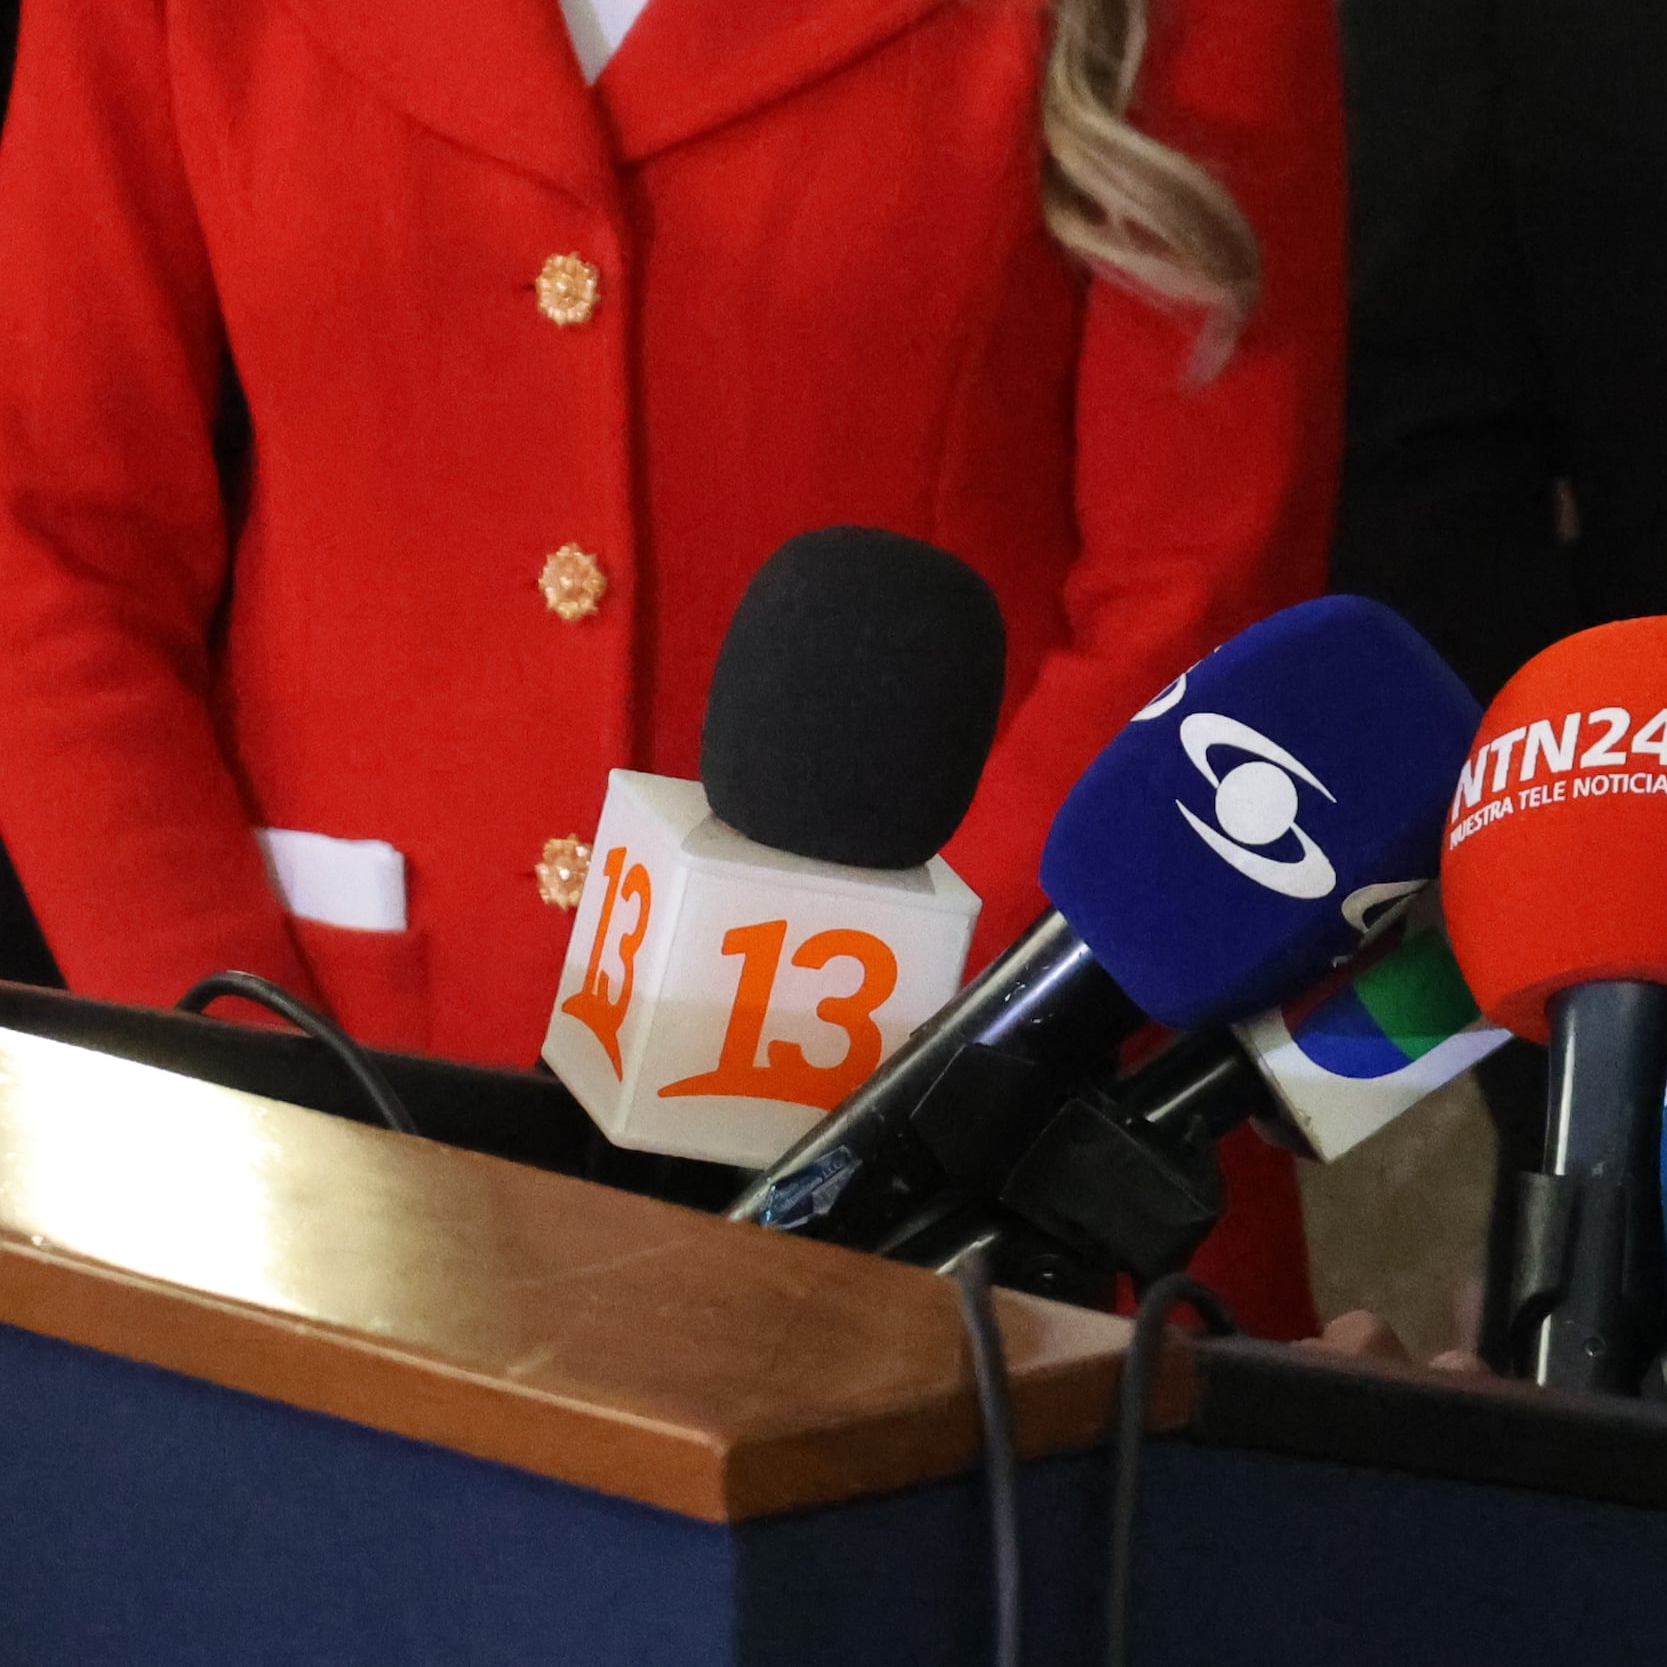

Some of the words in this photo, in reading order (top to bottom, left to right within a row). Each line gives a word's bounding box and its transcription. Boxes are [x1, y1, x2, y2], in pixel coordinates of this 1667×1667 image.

[1449, 796, 1514, 851] NUESTRA
[1518, 780, 1567, 811] TELE
[562, 846, 651, 1081] 13
[657, 920, 897, 1111] 13
